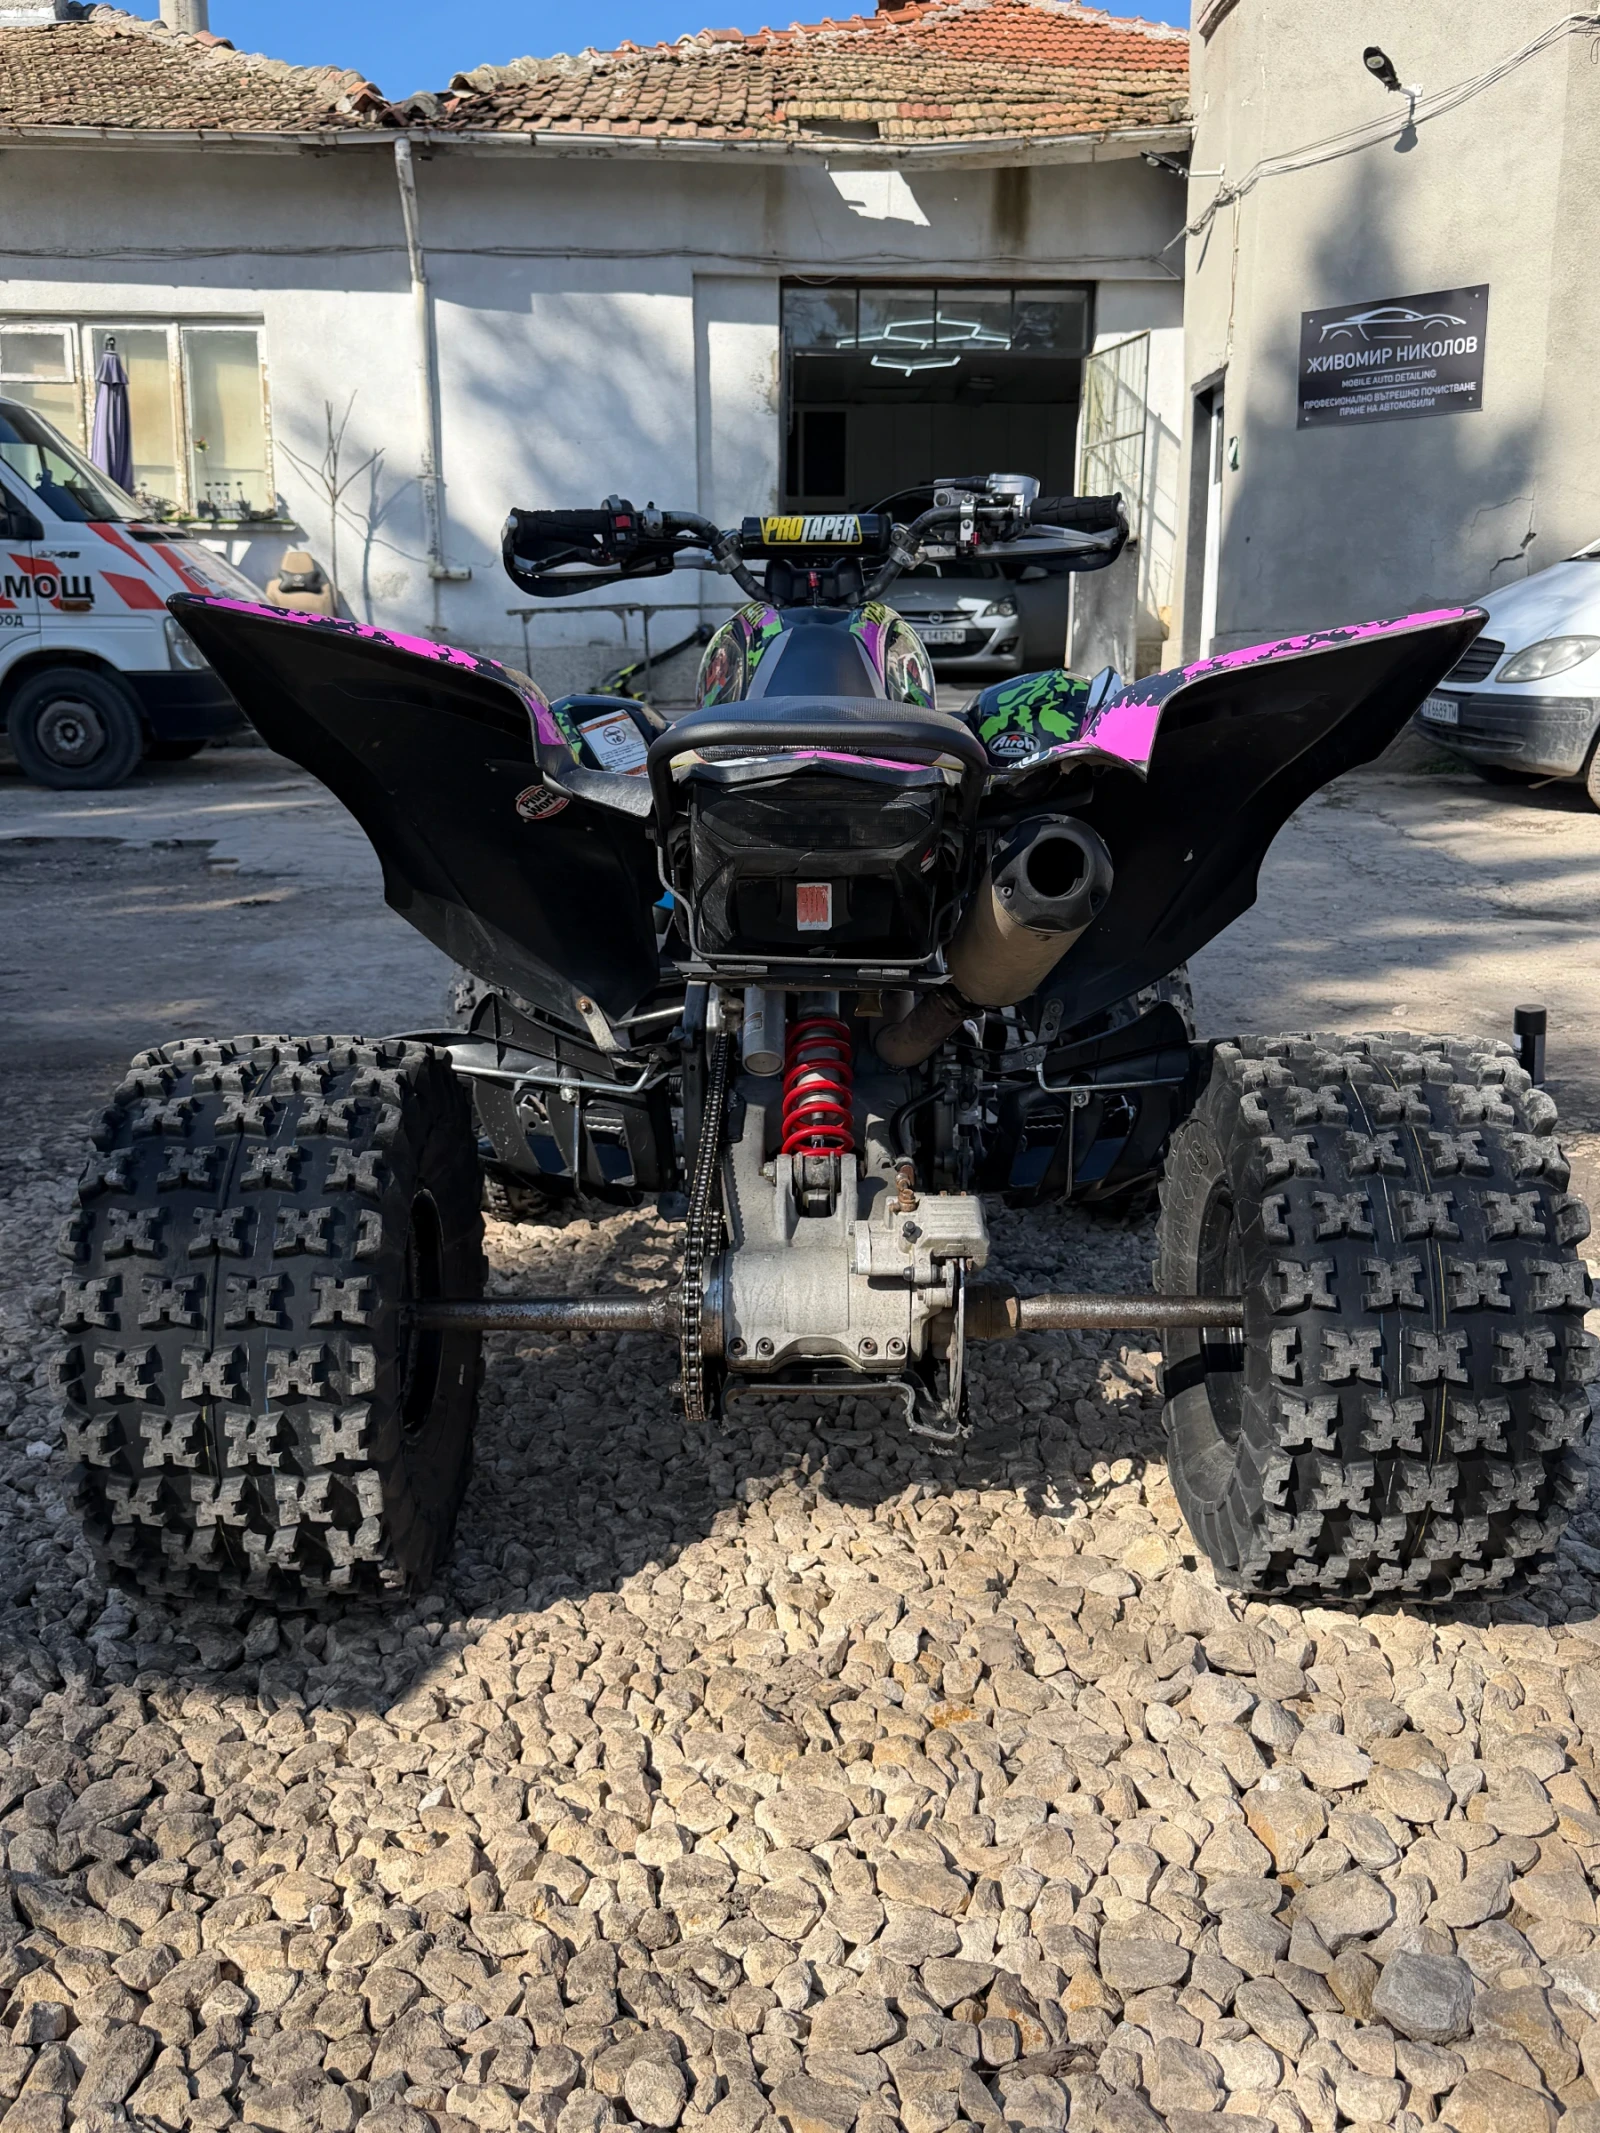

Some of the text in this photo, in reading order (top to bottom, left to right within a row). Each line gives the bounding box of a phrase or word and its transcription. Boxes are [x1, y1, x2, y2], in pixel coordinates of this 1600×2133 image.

[1306, 335, 1478, 373] ЖИВОМИР НИКОЛОВ
[1341, 369, 1437, 388] MOBILE AUTO DETAILING
[1303, 381, 1477, 410] ПРОФЕСИОНАЛНО ВЪТРЕШНО ПОЧИСТВАНЕ
[1339, 397, 1436, 416] ПРАНЕ НА АВТОМОБИЛИ
[765, 515, 857, 543] PROTAPER
[0, 574, 95, 603] МОЩ
[992, 735, 1035, 751] Airoh
